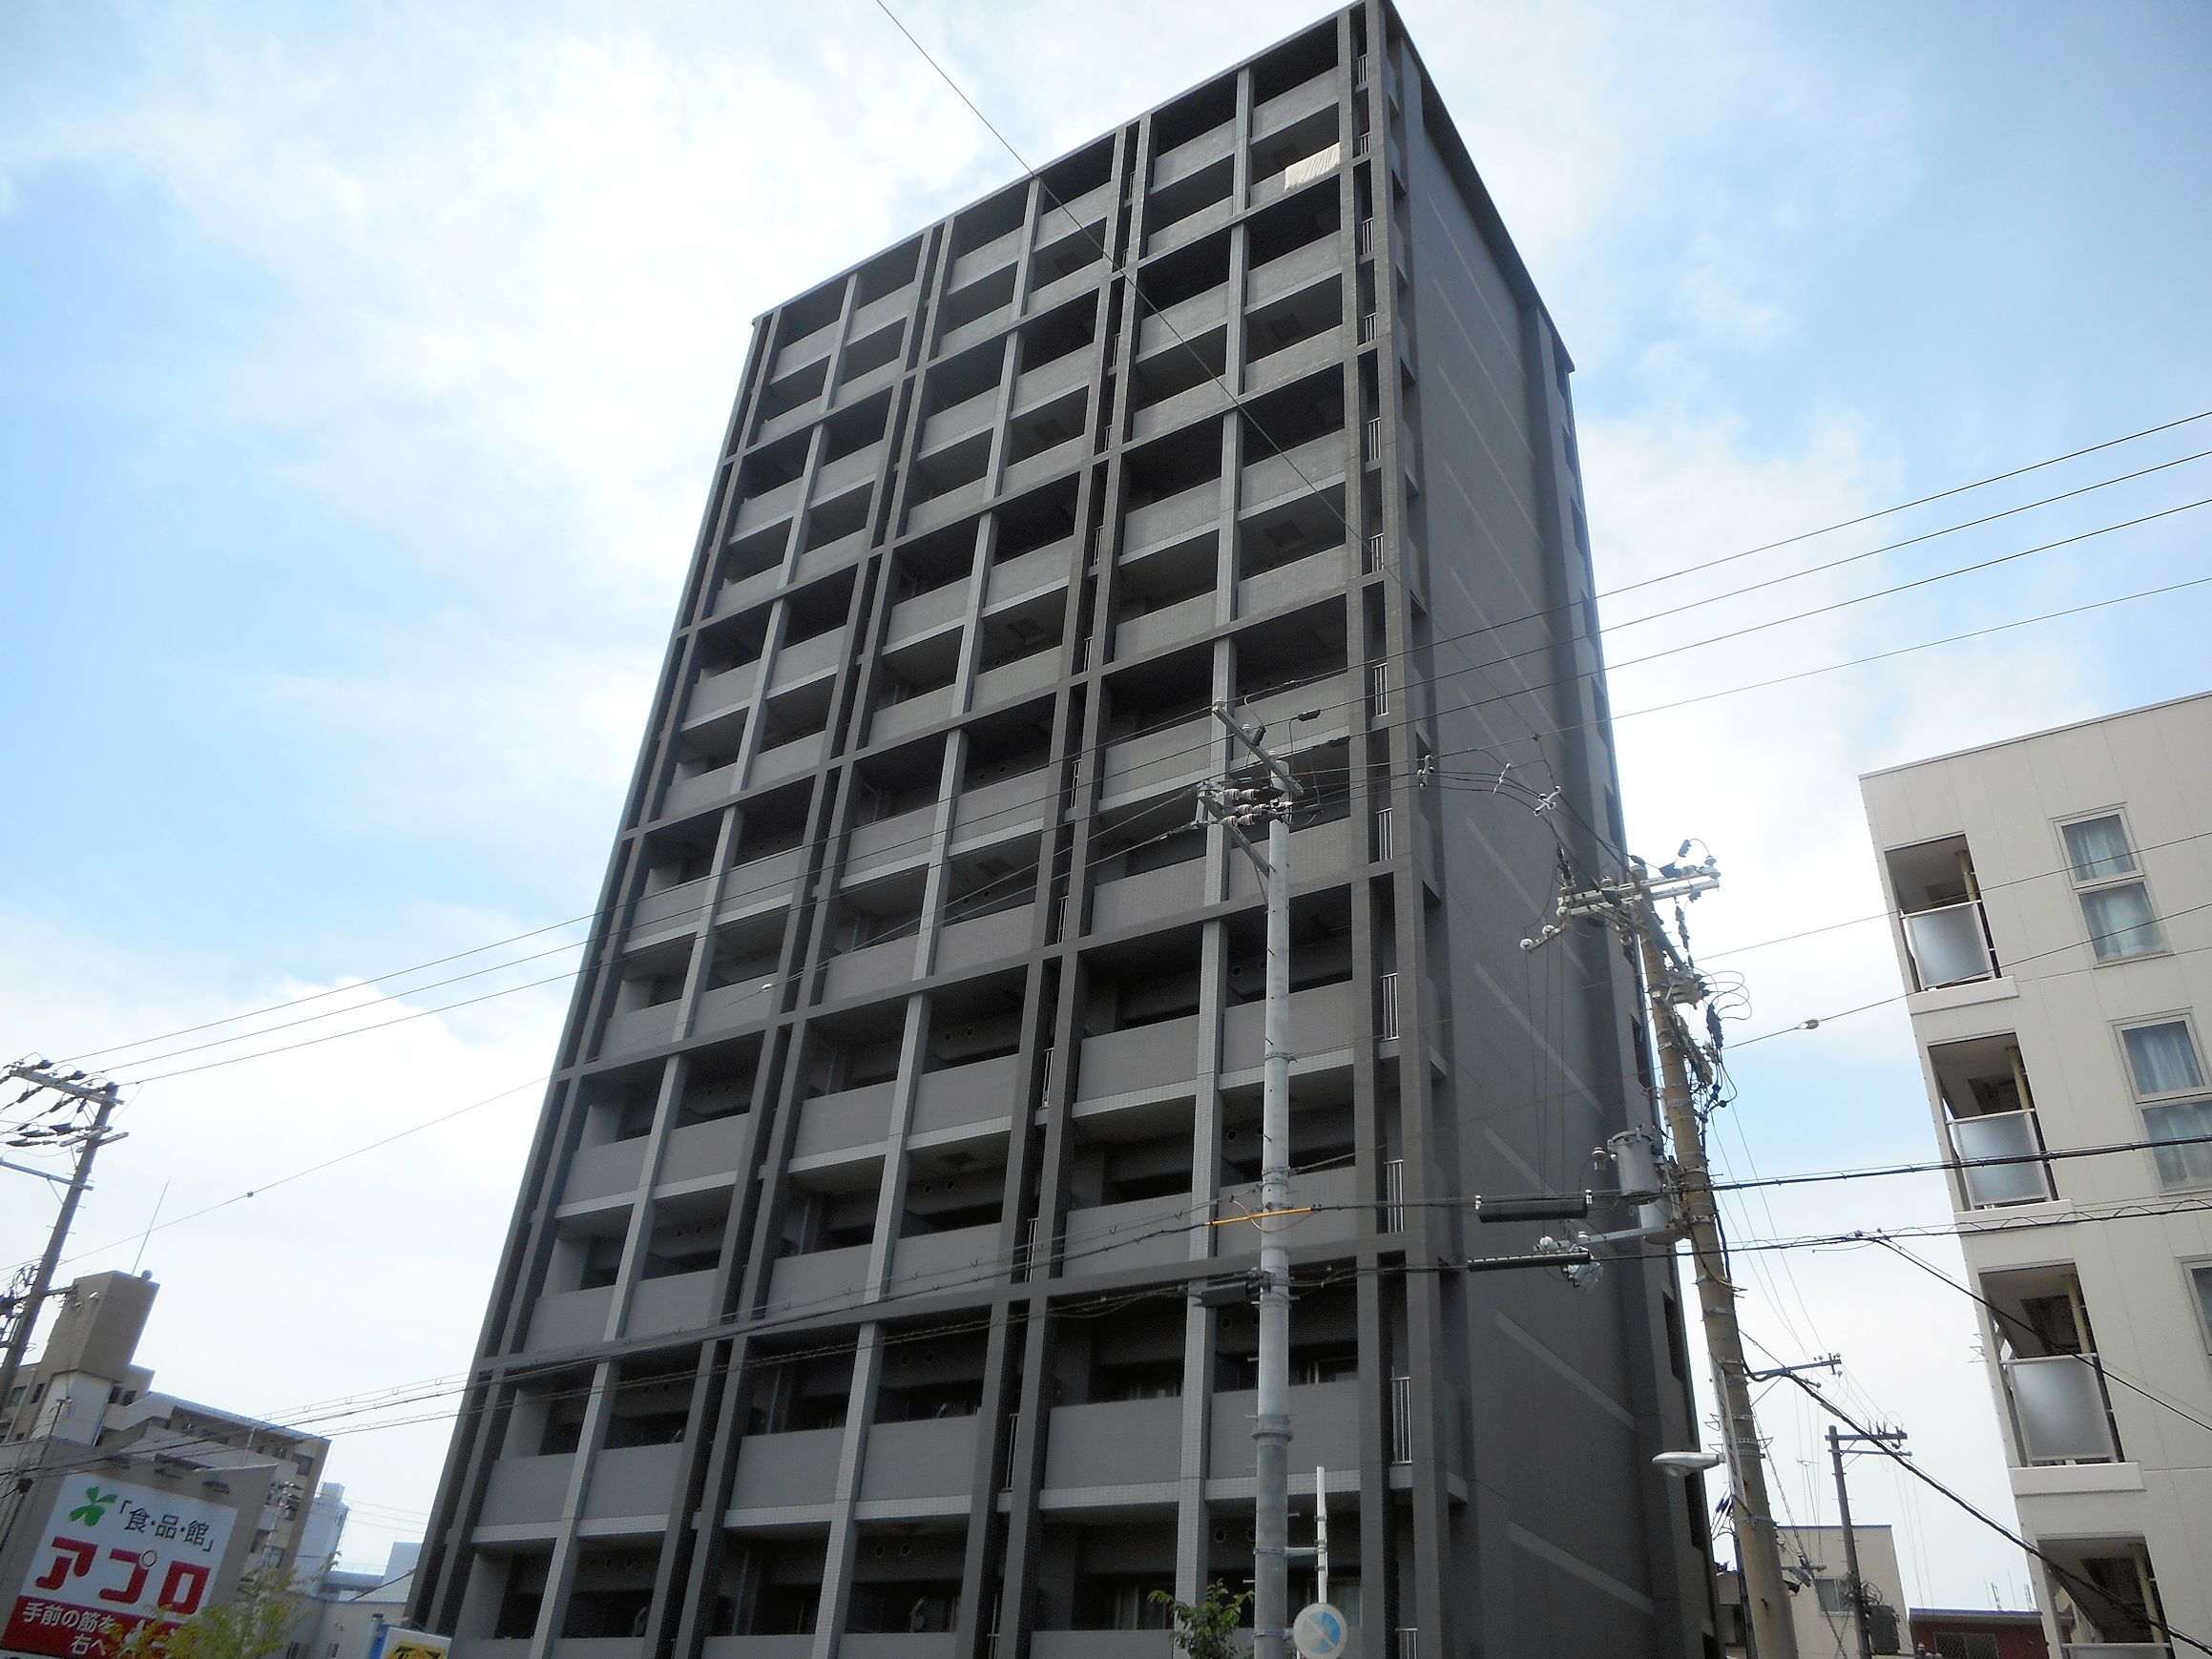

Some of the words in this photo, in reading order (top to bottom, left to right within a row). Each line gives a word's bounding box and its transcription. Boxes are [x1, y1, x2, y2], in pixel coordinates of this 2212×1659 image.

[35, 1536, 212, 1615] アプロ
[23, 1602, 115, 1633] 手前の筋を
[71, 1633, 106, 1656] 右へ
